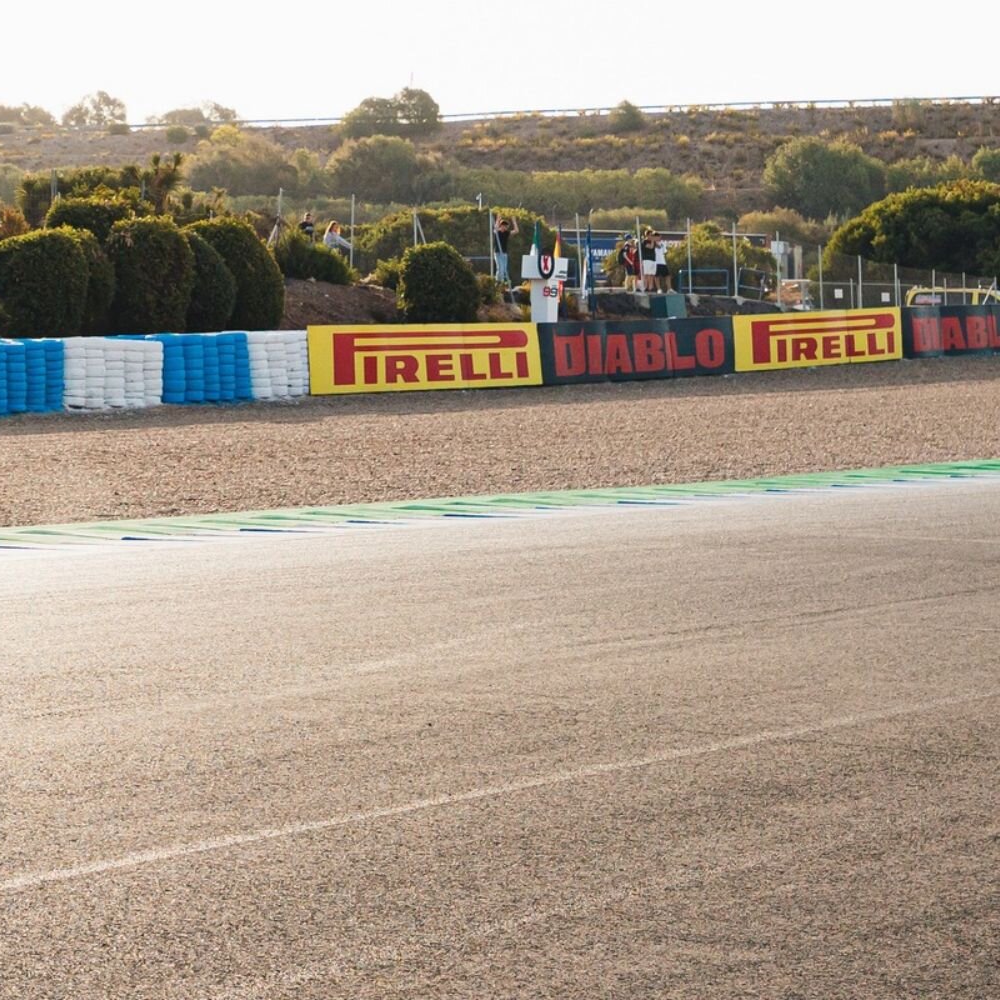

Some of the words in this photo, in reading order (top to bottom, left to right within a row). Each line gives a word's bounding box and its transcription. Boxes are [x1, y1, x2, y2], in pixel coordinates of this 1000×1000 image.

[333, 330, 529, 385] PIRELLI
[553, 328, 726, 377] DIABLO
[751, 313, 895, 364] PIRELLI
